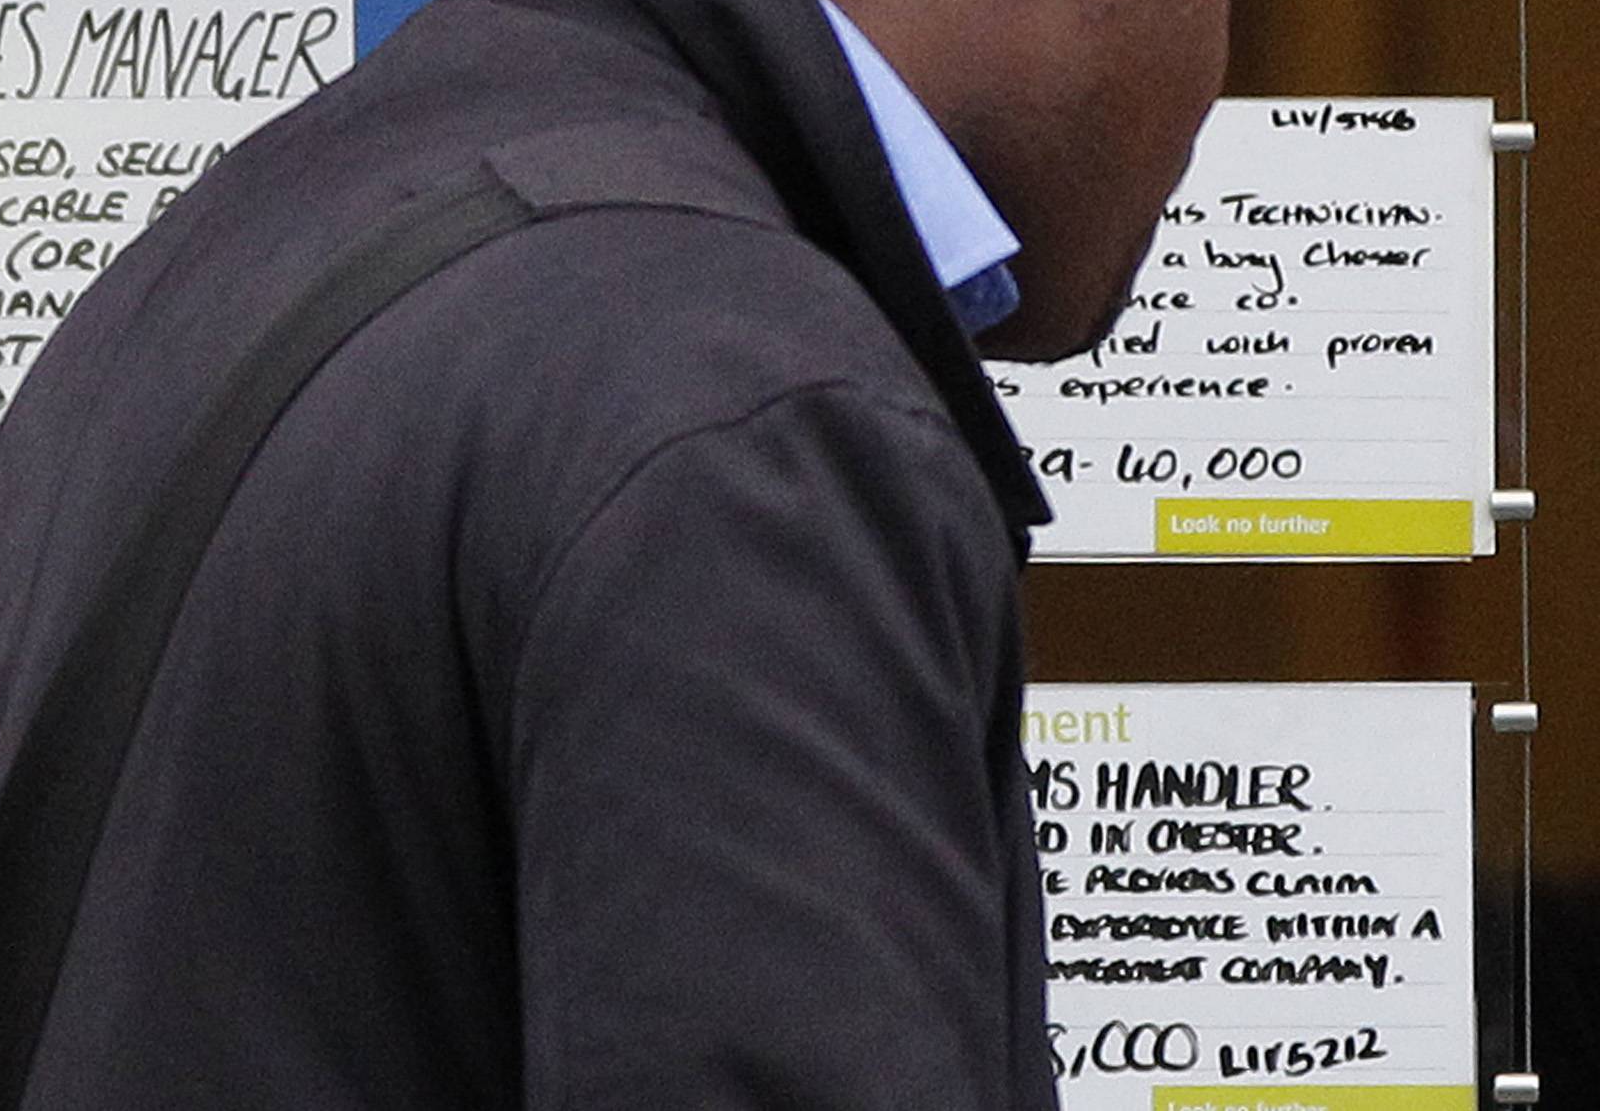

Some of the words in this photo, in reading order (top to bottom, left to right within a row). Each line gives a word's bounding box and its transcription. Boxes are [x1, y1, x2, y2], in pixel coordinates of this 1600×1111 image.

[55, 7, 339, 103] MANAGER
[1163, 253, 1185, 267] a
[1172, 516, 1219, 533] Look
[1227, 520, 1251, 532] no
[1259, 515, 1329, 534] further
[1091, 821, 1134, 854] IN
[1412, 910, 1441, 940] A
